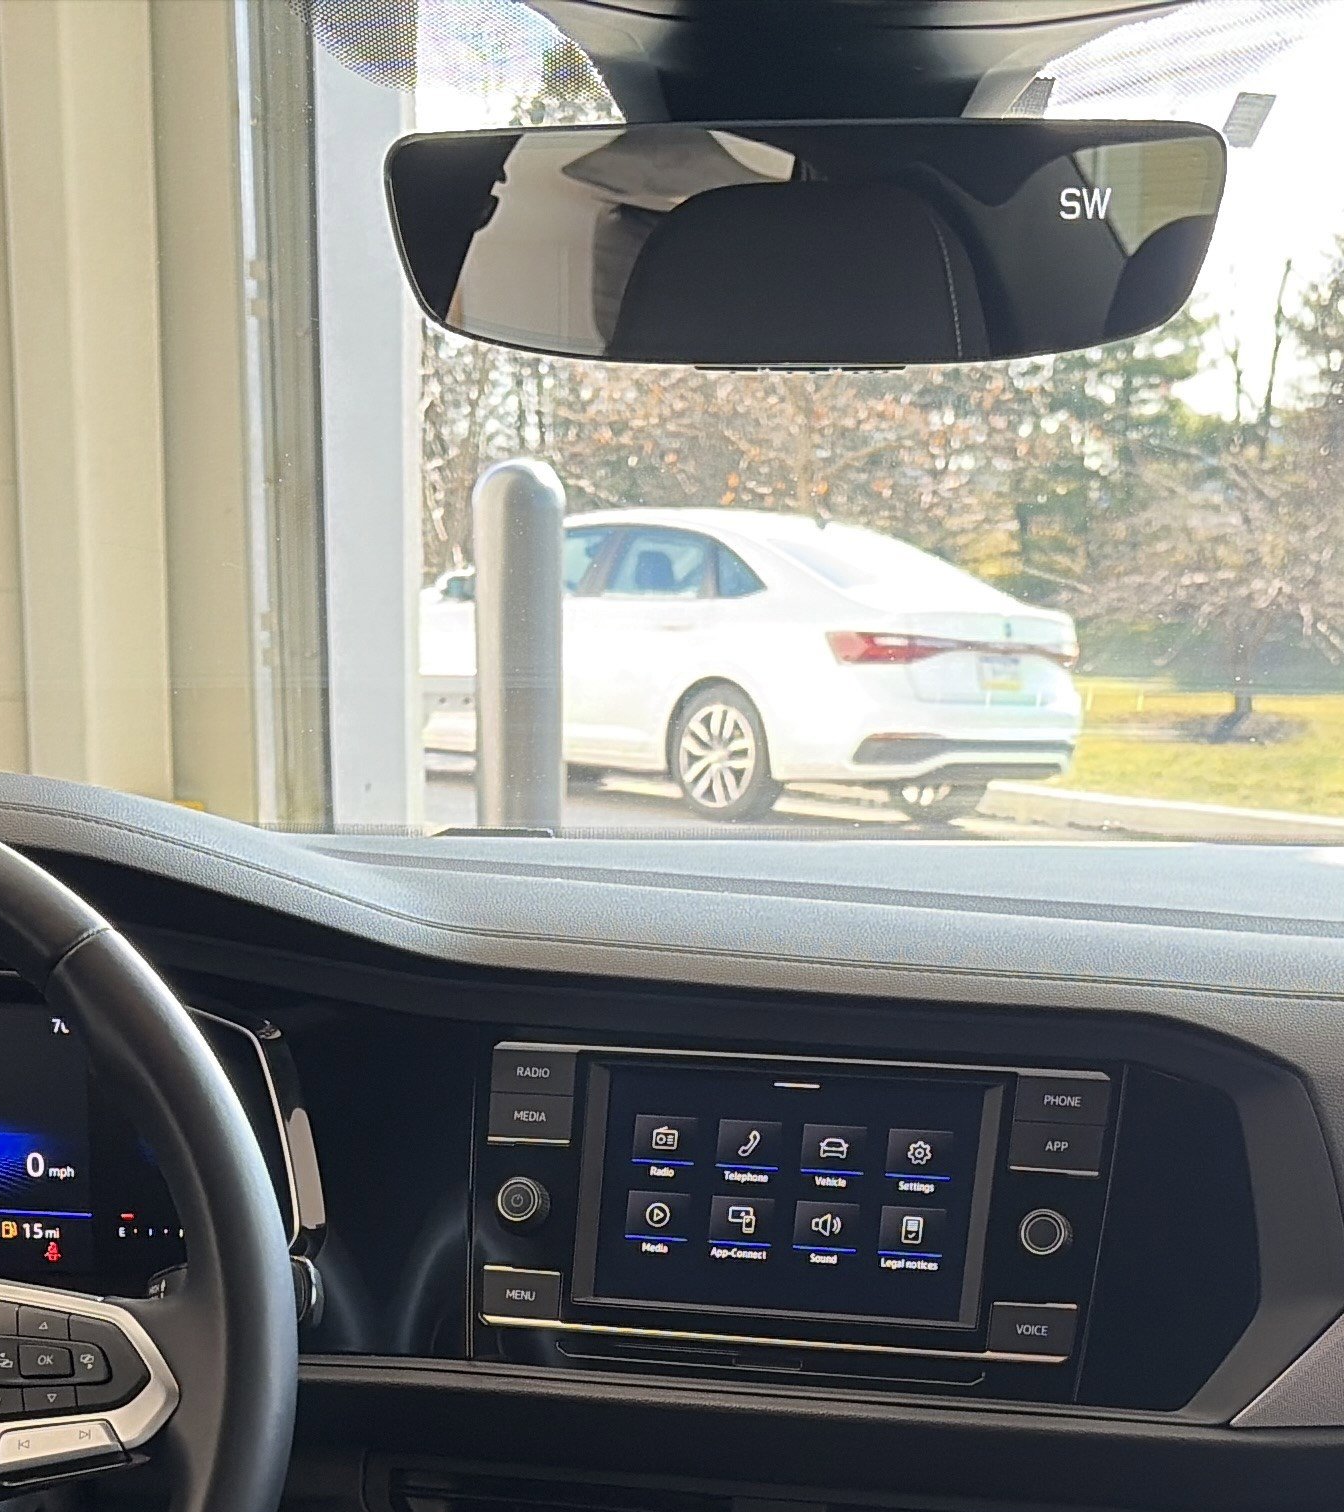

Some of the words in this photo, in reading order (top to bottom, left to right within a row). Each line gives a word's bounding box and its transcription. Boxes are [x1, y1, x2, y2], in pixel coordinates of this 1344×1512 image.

[1059, 187, 1112, 220] SW
[516, 1066, 551, 1078] RADIO
[1043, 1094, 1082, 1107] PHONE
[513, 1110, 547, 1122] MEDIA
[1044, 1140, 1069, 1152] APP
[26, 1152, 45, 1178] 0
[48, 1165, 75, 1180] mph
[649, 1166, 675, 1178] Radio
[724, 1170, 769, 1183] Telephone
[814, 1175, 847, 1188] Vehicle
[898, 1180, 935, 1194] Settings
[22, 1222, 43, 1239] 15
[45, 1227, 60, 1239] mi
[641, 1242, 669, 1254] Media
[710, 1246, 767, 1260] App-Connect
[809, 1252, 838, 1265] Sound
[880, 1257, 904, 1270] Legal
[905, 1260, 939, 1271] notices
[505, 1288, 536, 1301] MENU
[1016, 1323, 1049, 1336] VOICE
[37, 1354, 54, 1366] OK
